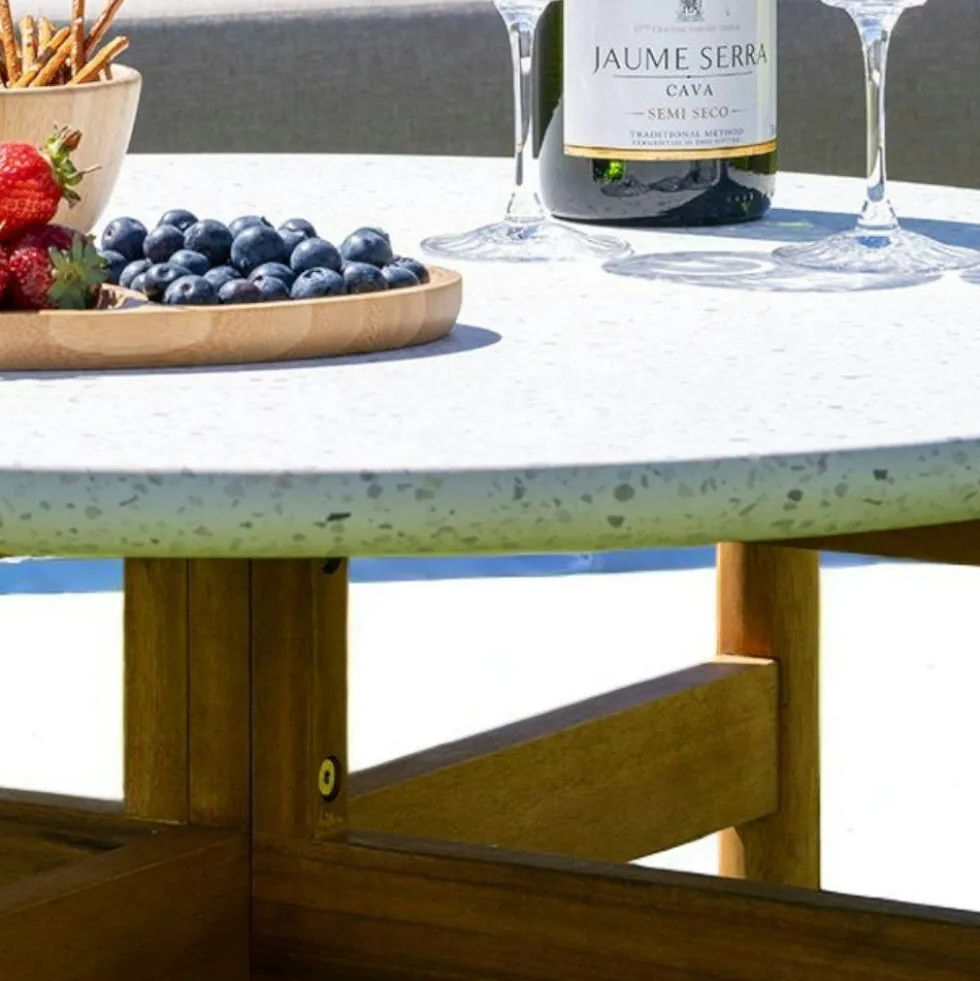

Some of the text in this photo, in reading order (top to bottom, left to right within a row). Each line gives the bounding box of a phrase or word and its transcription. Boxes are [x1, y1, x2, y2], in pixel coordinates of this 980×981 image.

[593, 43, 767, 74] JAUME SERRA
[666, 84, 713, 97] CAVA
[648, 107, 729, 120] SEMI SECO
[630, 128, 744, 139] TRADITIONAL METHOD
